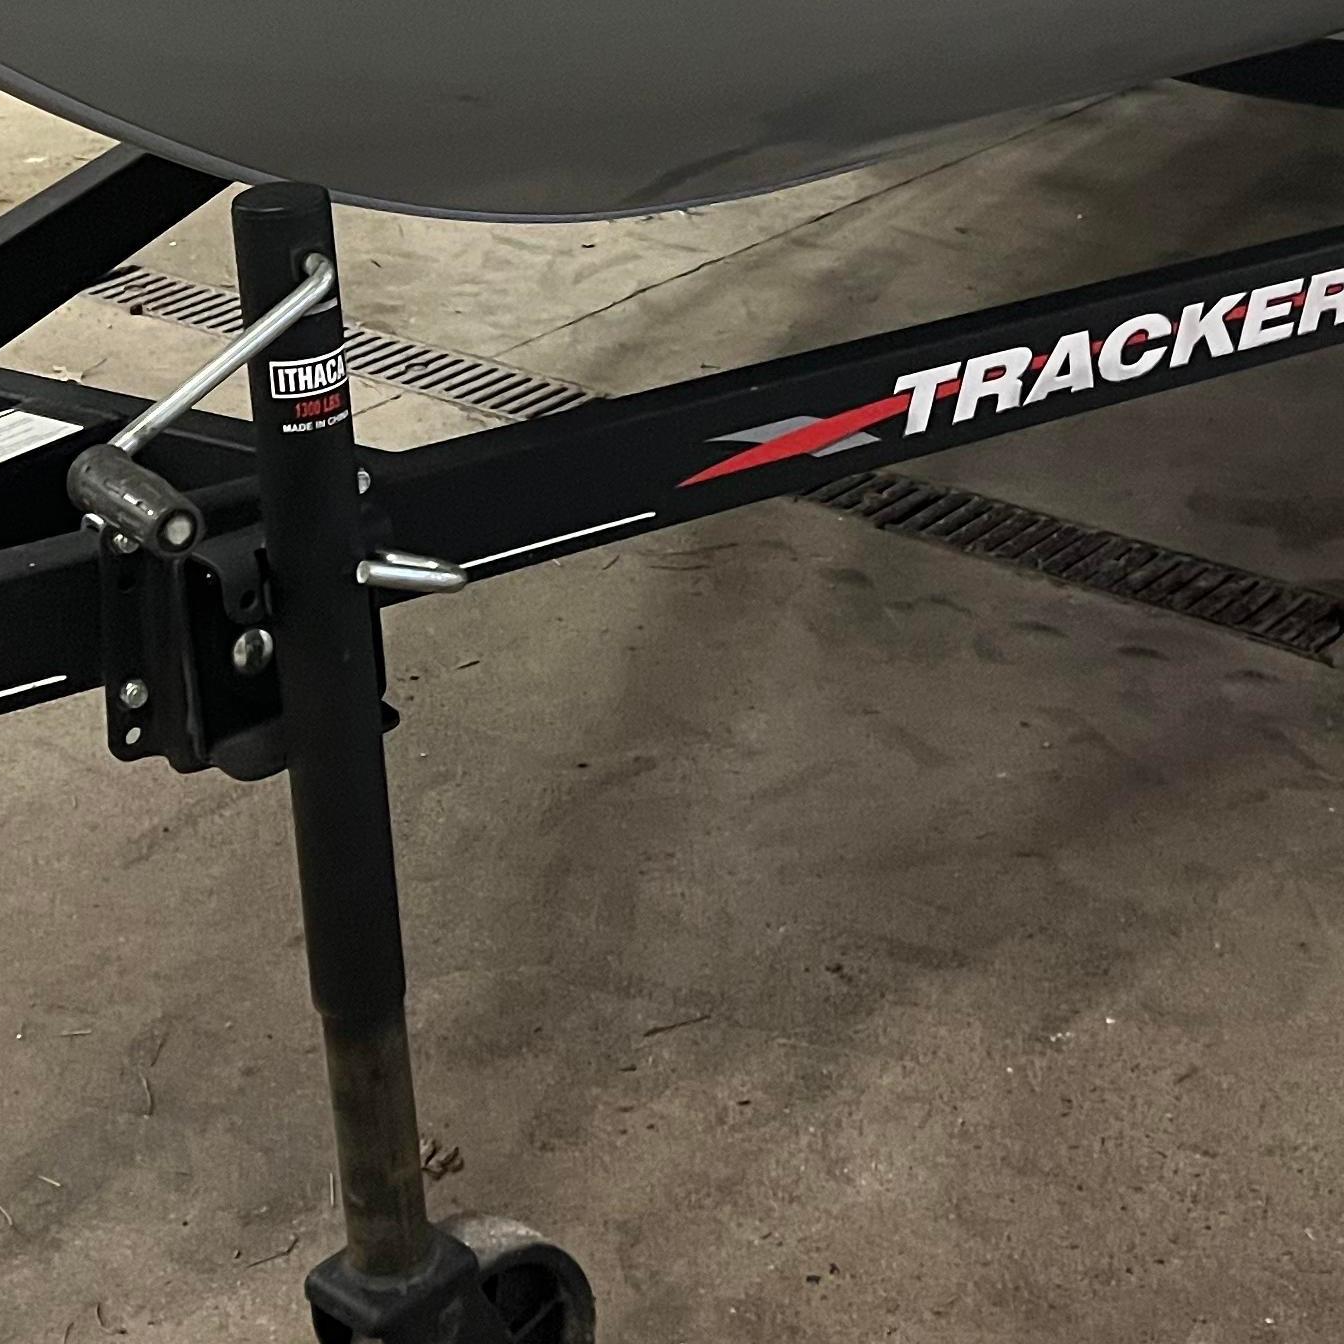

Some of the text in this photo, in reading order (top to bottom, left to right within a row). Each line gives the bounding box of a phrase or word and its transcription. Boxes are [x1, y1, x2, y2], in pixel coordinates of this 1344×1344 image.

[277, 354, 345, 392] ITHACA
[282, 421, 314, 432] MADE
[316, 419, 326, 429] IN
